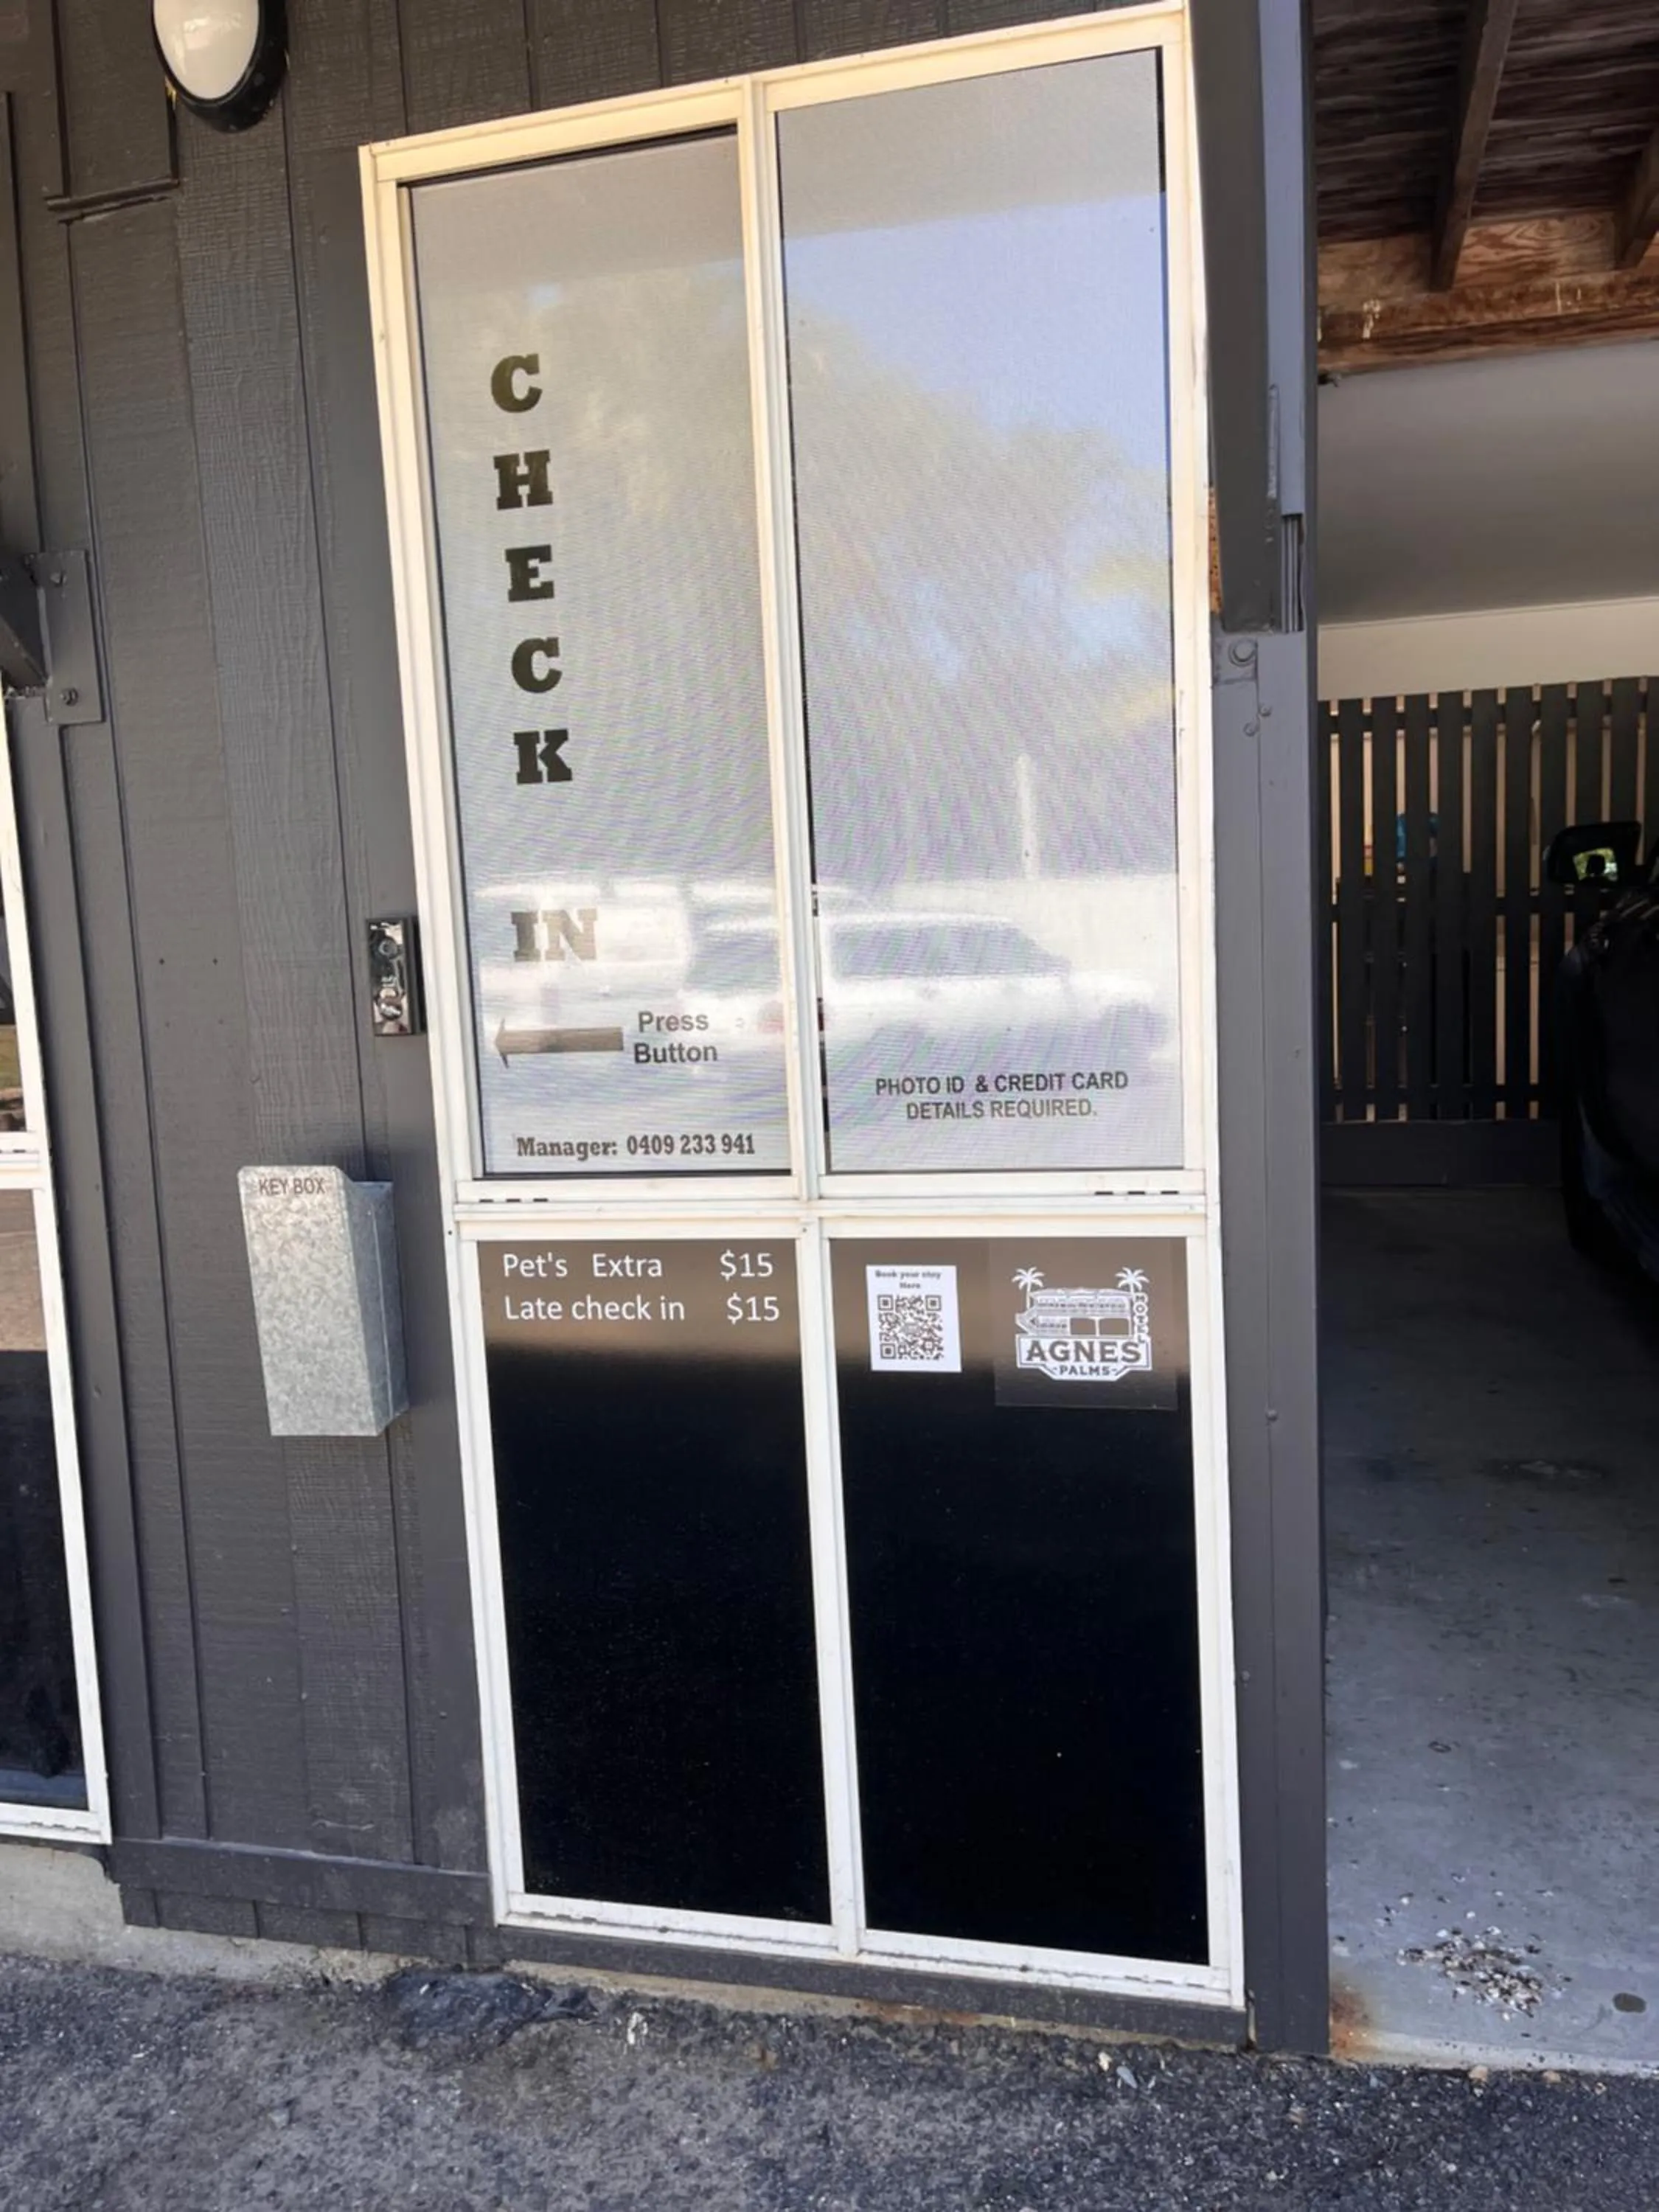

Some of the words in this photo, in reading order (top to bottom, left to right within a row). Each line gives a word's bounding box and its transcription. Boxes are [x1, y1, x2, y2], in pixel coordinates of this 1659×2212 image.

[491, 353, 573, 785] CHECK
[511, 908, 598, 961] IN
[639, 1012, 709, 1032] Press
[634, 1041, 718, 1064] Button
[876, 1076, 940, 1096] PHOTO
[947, 1077, 964, 1094] ID
[975, 1075, 989, 1092] &
[995, 1073, 1065, 1092] CREDIT
[1071, 1071, 1129, 1091] CARD
[907, 1101, 984, 1120] DETAILS
[990, 1098, 1097, 1119] REQUIRED.
[517, 1137, 617, 1161] Manager:
[627, 1135, 675, 1155] 0409
[680, 1134, 716, 1155] 233
[721, 1133, 756, 1155] 941
[259, 1178, 288, 1195] KEY
[294, 1178, 325, 1194] BOX
[503, 1253, 568, 1278] Pet's
[592, 1253, 663, 1278] Extra
[720, 1250, 773, 1281] $15
[900, 1271, 920, 1279] your
[504, 1295, 563, 1321] Late
[571, 1295, 652, 1321] check
[660, 1295, 686, 1320] in
[726, 1293, 780, 1324] $15
[1135, 1295, 1147, 1343] MOTEL
[1026, 1340, 1141, 1363] AGNES
